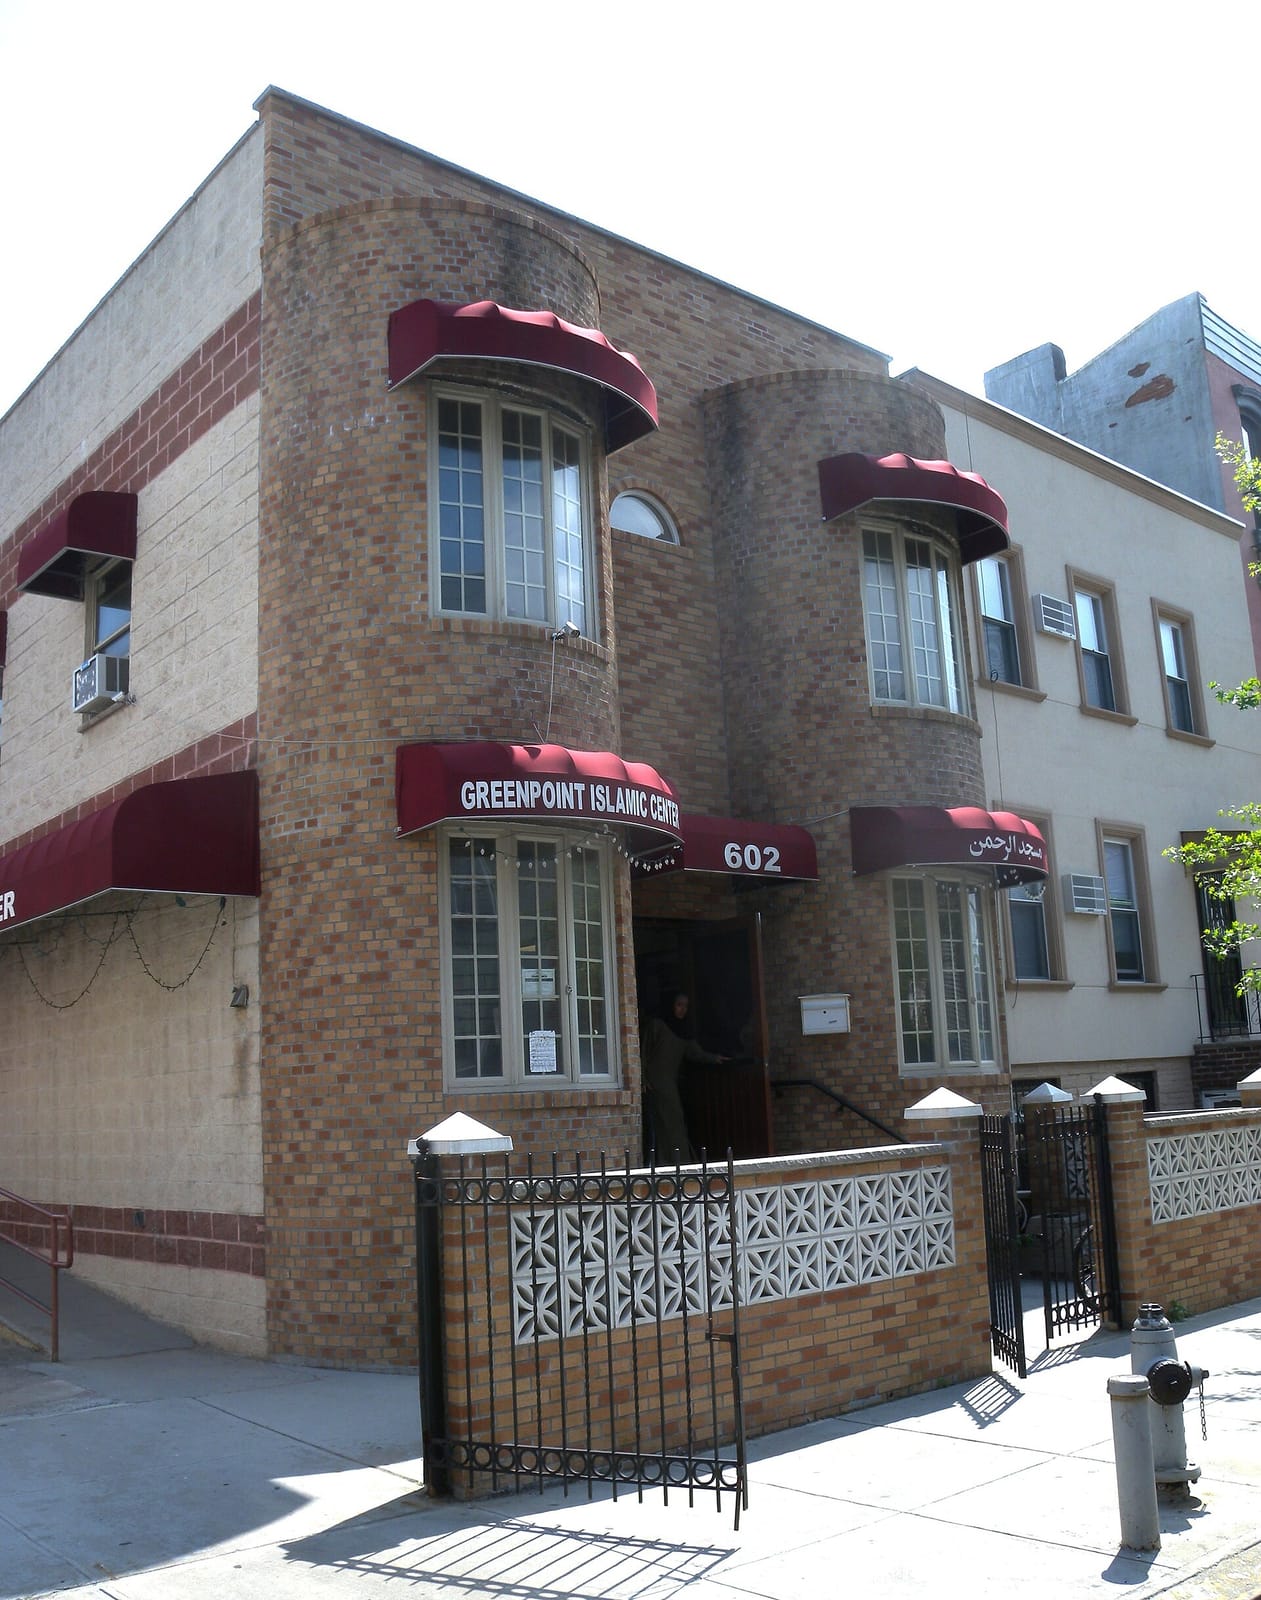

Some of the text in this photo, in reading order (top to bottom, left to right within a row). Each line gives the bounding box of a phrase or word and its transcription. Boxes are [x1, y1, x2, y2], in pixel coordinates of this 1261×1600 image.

[461, 780, 681, 830] GREENPOINT ISLAMIC CENTER
[724, 842, 782, 872] 602
[969, 835, 1017, 861] الرحمن
